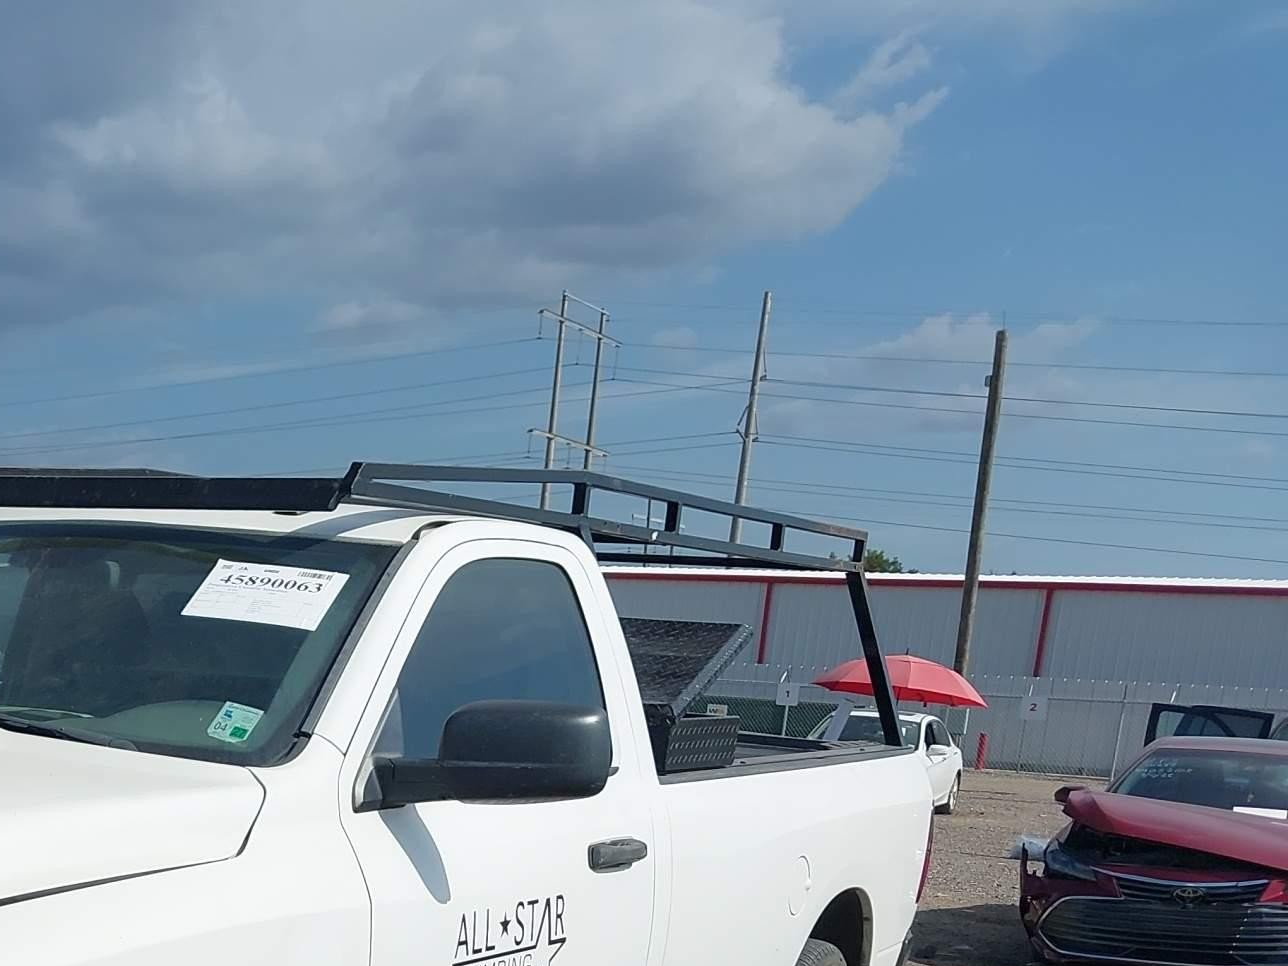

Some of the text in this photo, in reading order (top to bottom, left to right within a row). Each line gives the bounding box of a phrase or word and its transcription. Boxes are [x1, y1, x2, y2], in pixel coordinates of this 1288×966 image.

[220, 574, 324, 595] 45890063
[1030, 703, 1037, 711] 2
[214, 721, 228, 731] 04
[454, 894, 565, 959] ALL STAR
